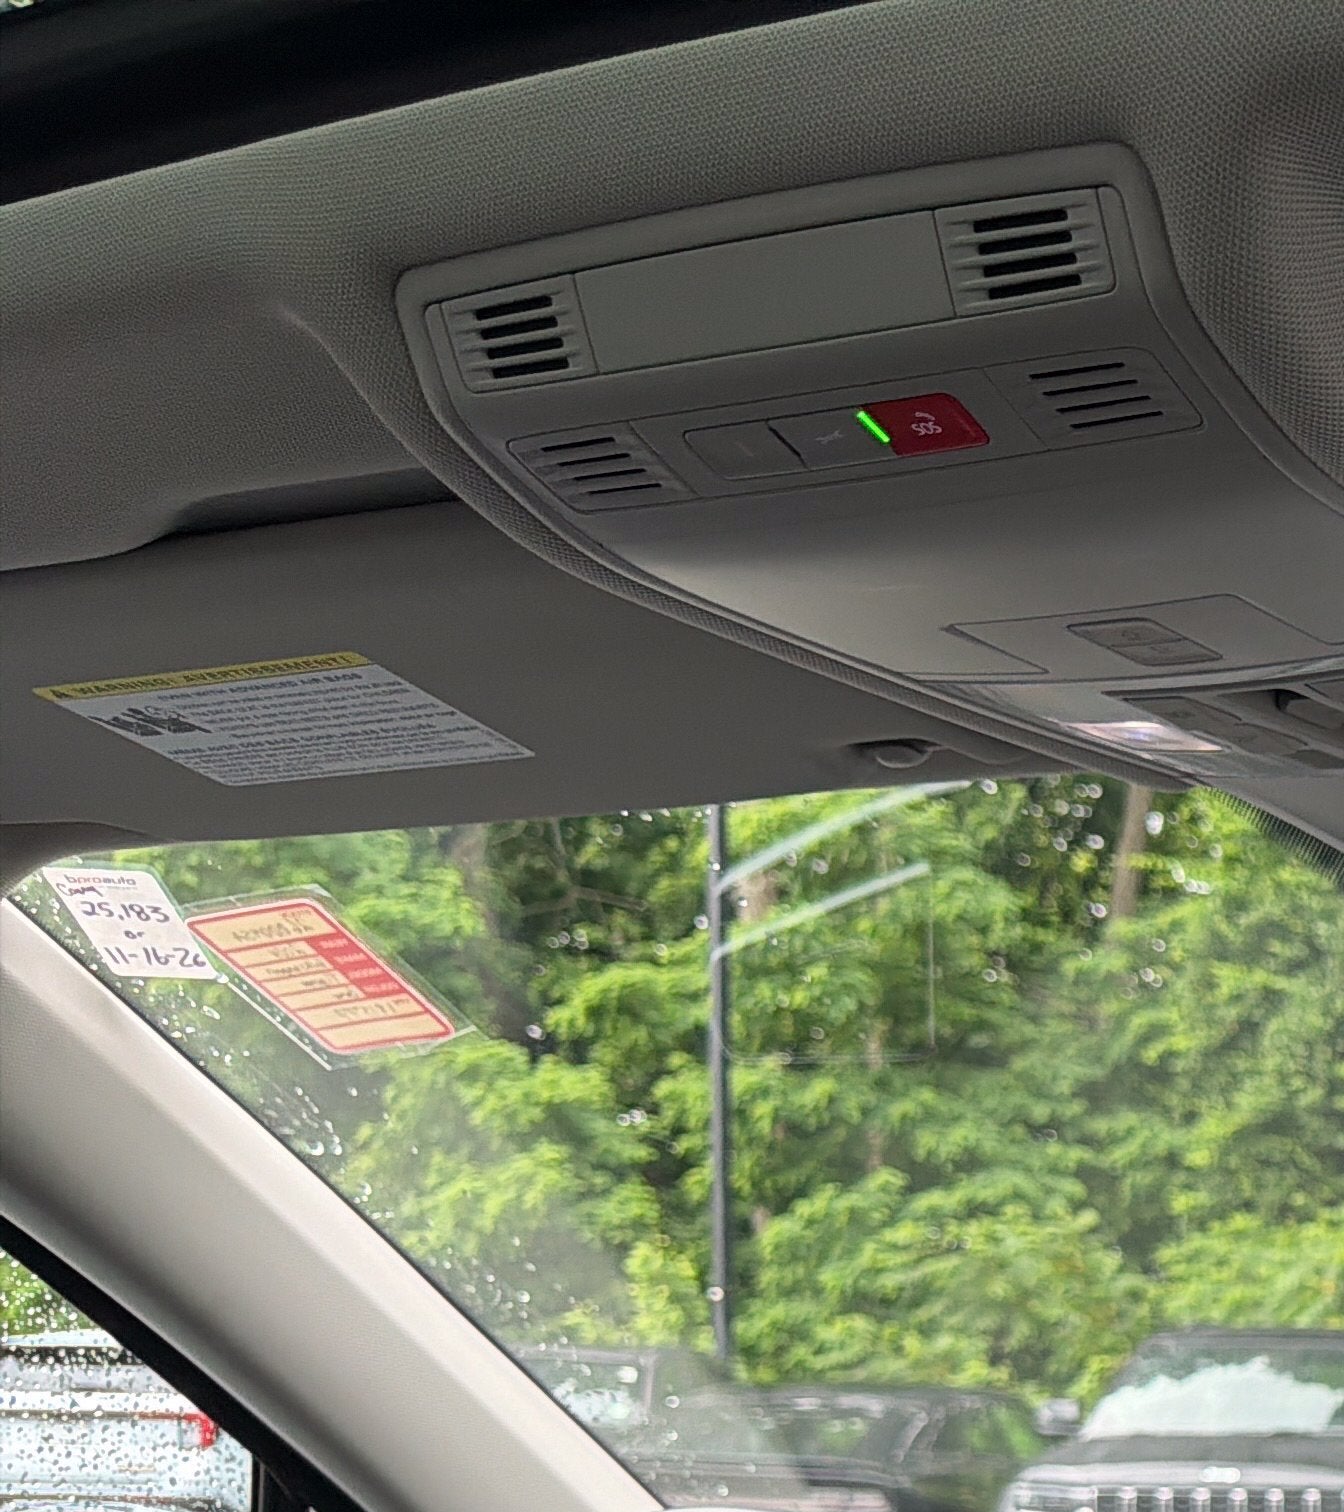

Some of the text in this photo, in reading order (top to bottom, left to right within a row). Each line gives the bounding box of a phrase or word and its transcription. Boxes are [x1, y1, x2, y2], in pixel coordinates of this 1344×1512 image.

[911, 421, 943, 437] SOS
[80, 901, 170, 923] 25,183
[123, 930, 145, 940] or
[103, 946, 207, 968] 11-16-26
